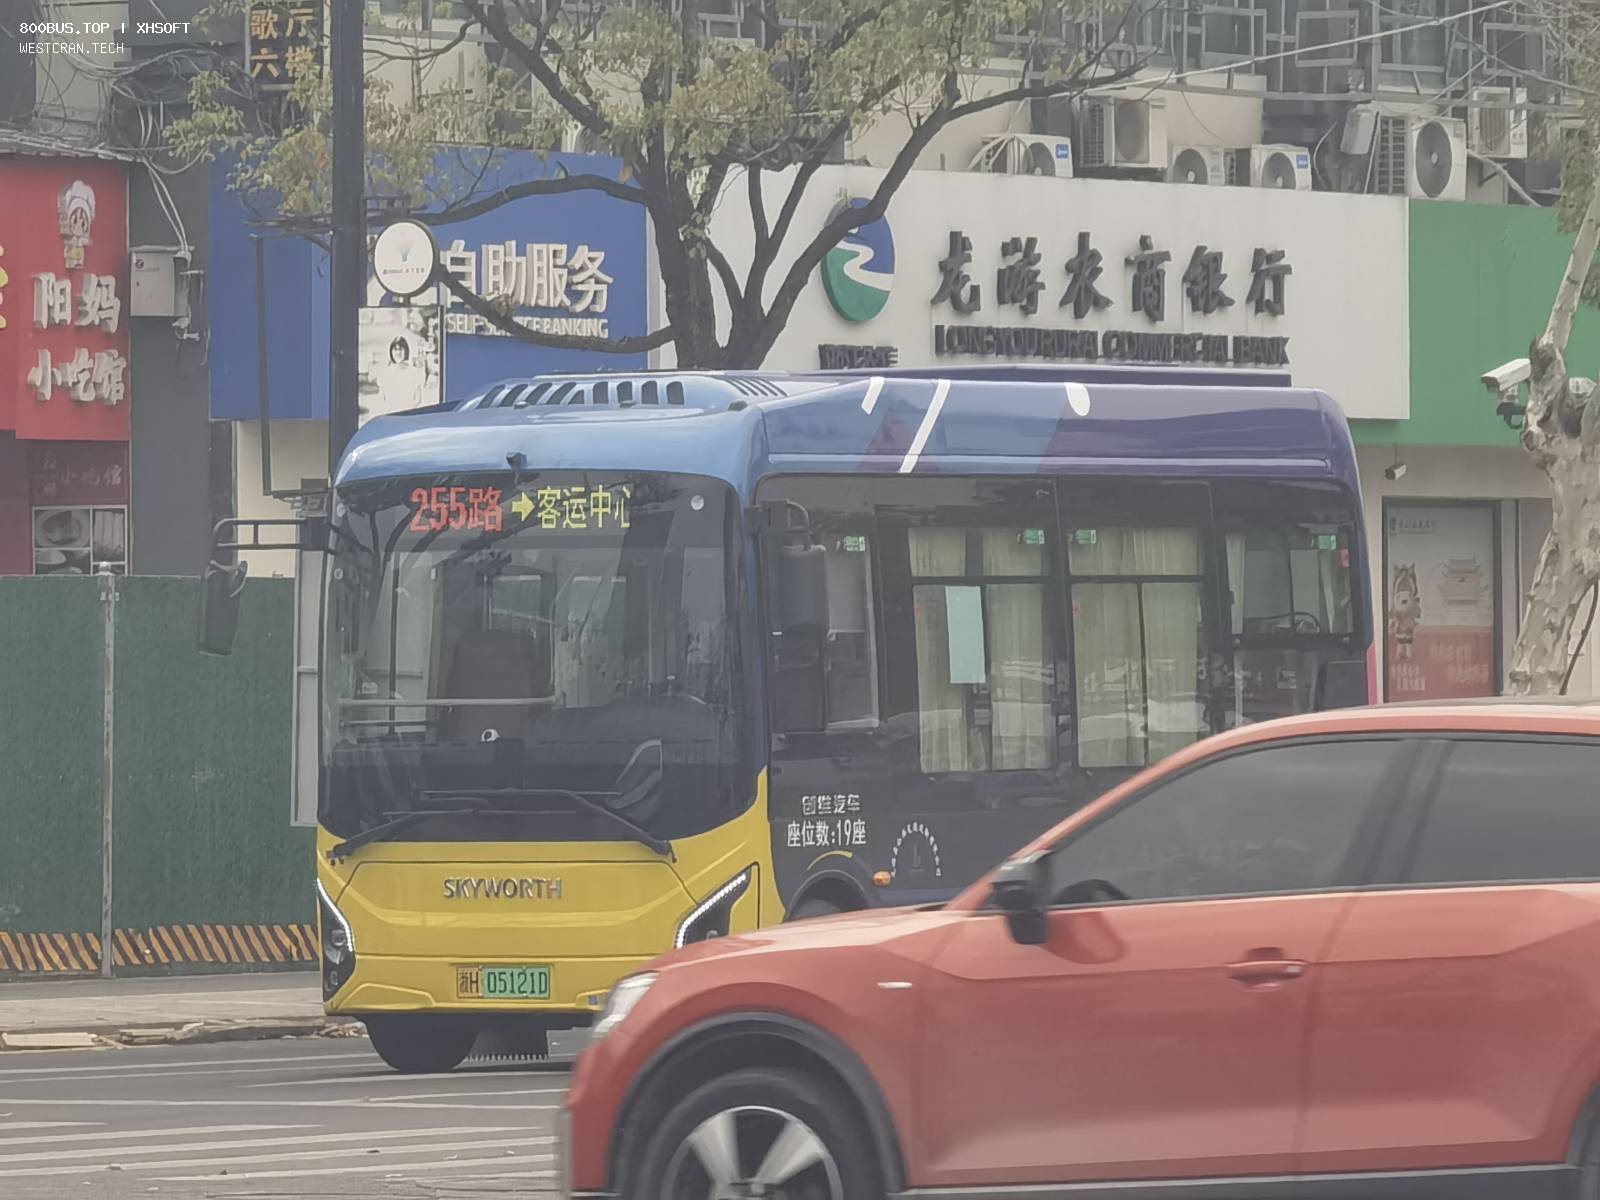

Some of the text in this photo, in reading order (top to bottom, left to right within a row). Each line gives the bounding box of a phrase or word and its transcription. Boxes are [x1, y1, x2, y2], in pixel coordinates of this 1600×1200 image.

[32, 272, 120, 333] 阳妈
[440, 239, 613, 313] 自助服务
[27, 348, 127, 405] 小吃馆
[409, 486, 504, 533] 255路
[443, 876, 563, 899] SKYWORTH
